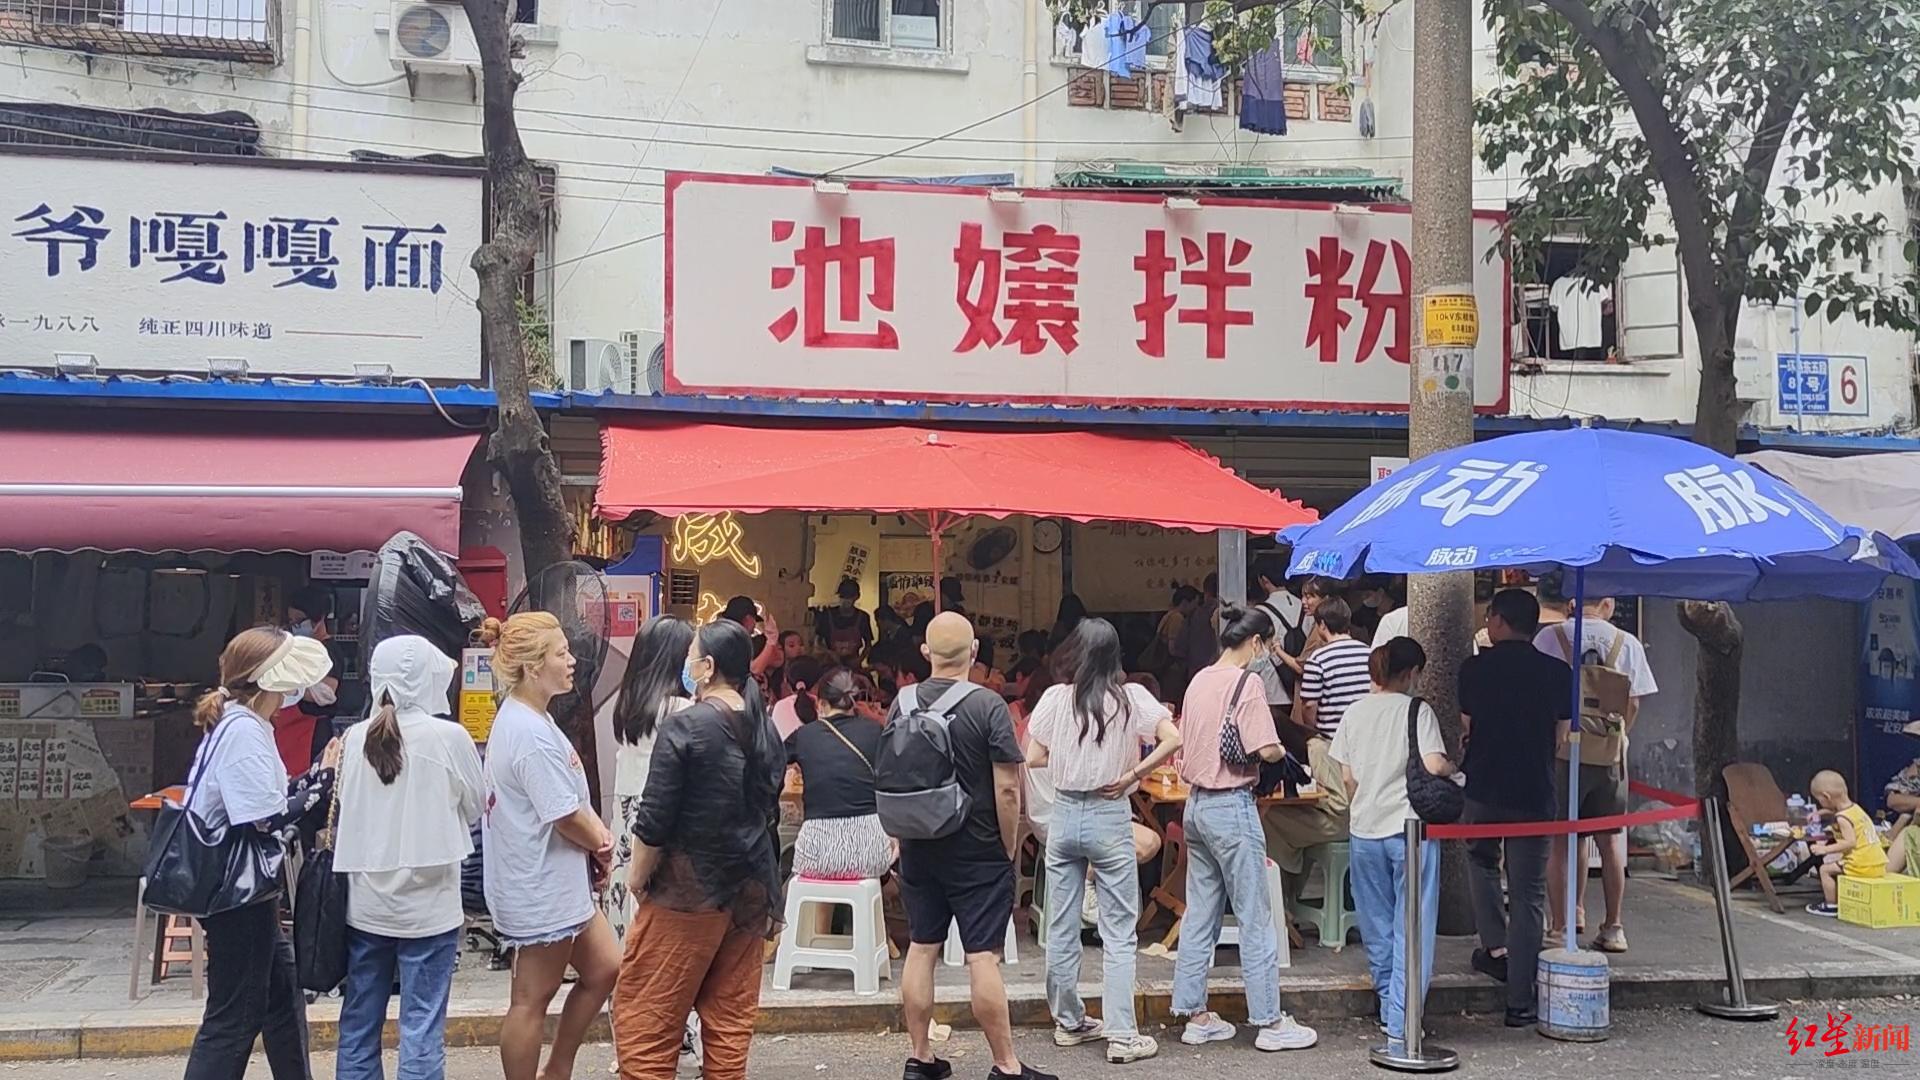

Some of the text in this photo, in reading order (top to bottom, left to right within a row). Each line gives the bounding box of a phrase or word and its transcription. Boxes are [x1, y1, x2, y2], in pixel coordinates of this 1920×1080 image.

[138, 317, 273, 340] 纯正四川味道
[1840, 364, 1858, 405] 6
[1424, 546, 1479, 567] 脉动
